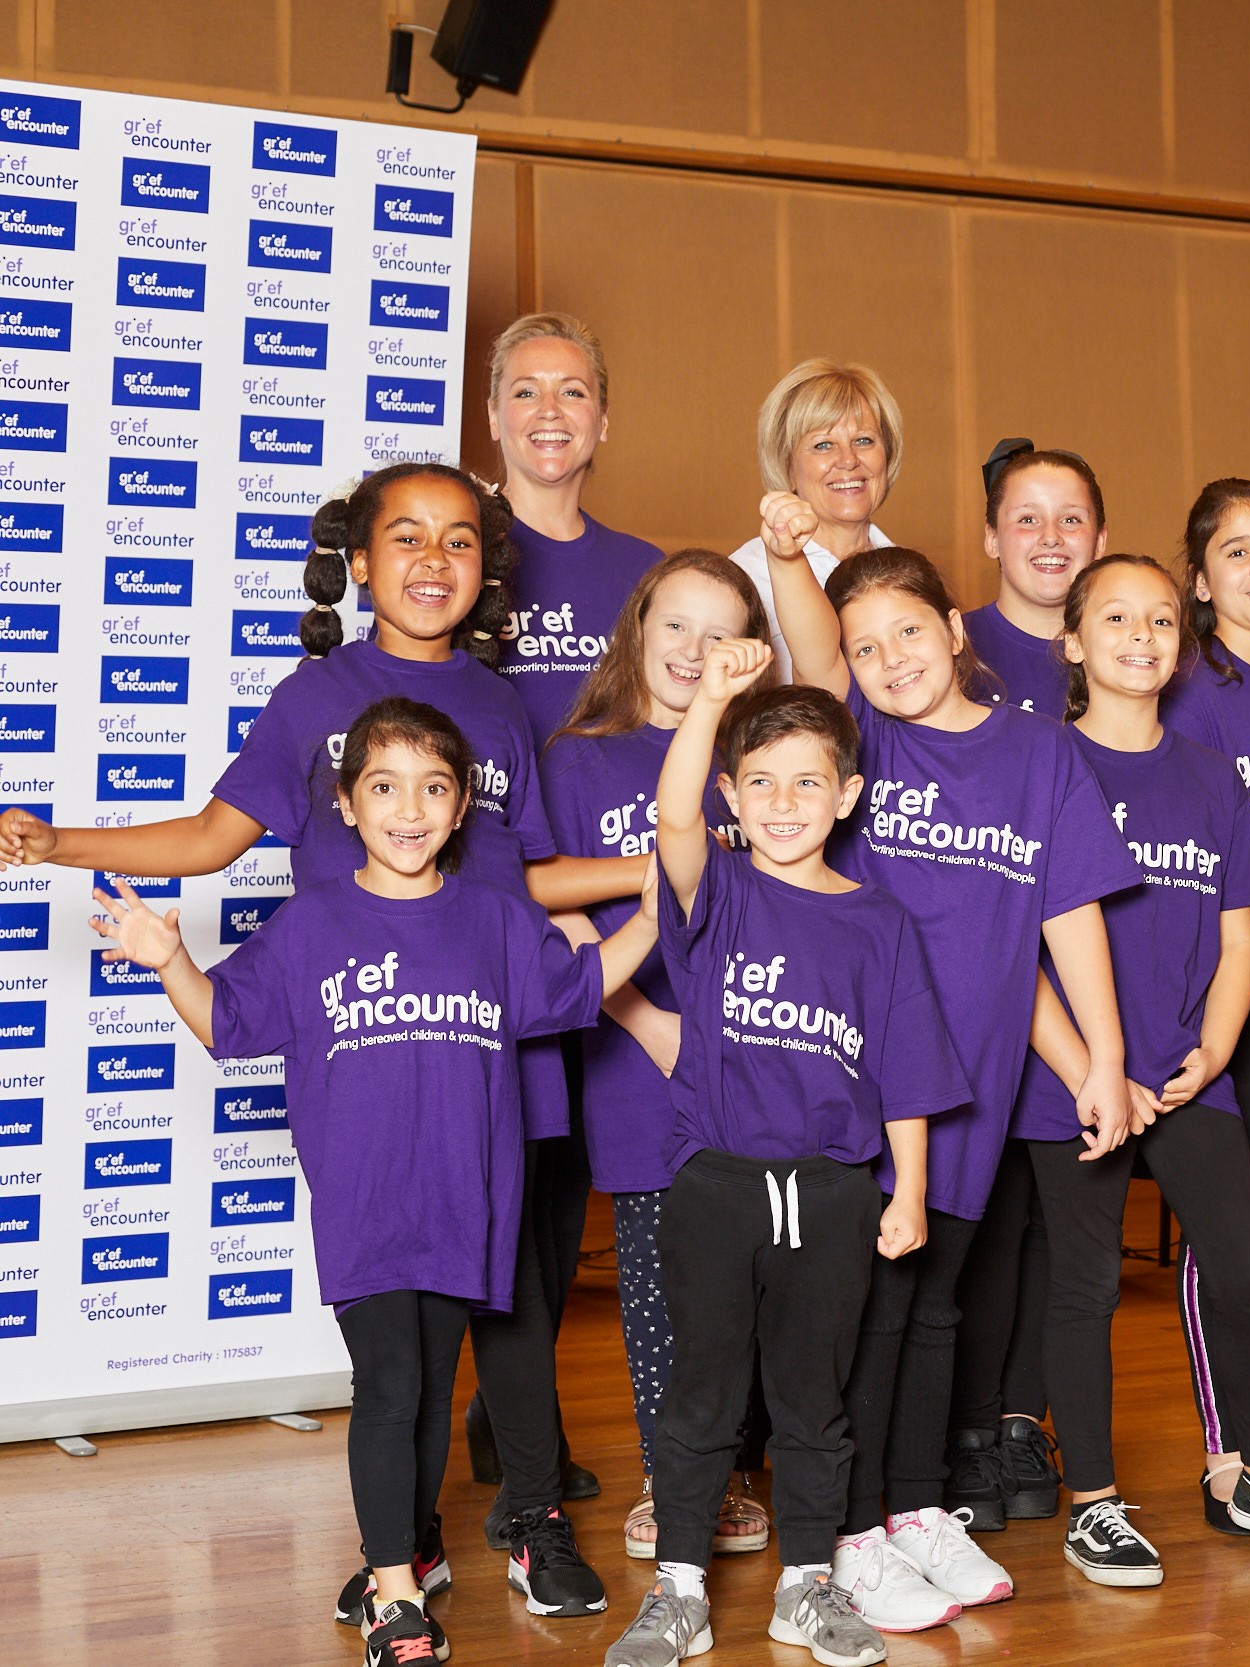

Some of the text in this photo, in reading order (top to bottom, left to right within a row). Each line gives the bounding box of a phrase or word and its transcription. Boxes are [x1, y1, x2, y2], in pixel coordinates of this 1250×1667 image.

[1, 107, 32, 122] gref
[7, 120, 69, 135] encounter
[124, 118, 163, 136] gref
[131, 134, 211, 153] encounter
[263, 137, 292, 151] gref
[268, 148, 326, 163] encounter
[377, 147, 412, 164] gref
[384, 162, 455, 180] encounter
[133, 173, 163, 187] gref
[139, 185, 199, 200] encounter
[252, 182, 289, 199] gref
[259, 197, 334, 215] encounter
[384, 199, 411, 213] gref
[389, 211, 444, 225] encounter
[373, 242, 409, 259] gref
[380, 258, 451, 274] encounter
[128, 272, 159, 286] gref
[133, 284, 194, 298] encounter
[247, 280, 284, 297] gref
[254, 296, 330, 312] encounter
[380, 294, 407, 308] gref
[385, 305, 440, 319] encounter
[115, 318, 154, 336] gref
[122, 334, 202, 350] encounter
[254, 332, 283, 346] gref
[259, 344, 317, 357] encounter
[376, 389, 404, 402] gref
[381, 401, 436, 413] encounter
[111, 418, 151, 436] gref
[119, 433, 198, 449] encounter
[250, 429, 279, 443] gref
[256, 441, 313, 453] encounter
[115, 570, 146, 585] gref
[121, 582, 182, 594] encounter
[498, 661, 549, 674] supporting
[551, 661, 590, 671] bereaved
[99, 715, 138, 733] gref
[106, 729, 186, 742] encounter
[870, 779, 940, 817] gref
[873, 810, 1042, 866] encounter
[937, 854, 976, 866] children
[978, 857, 986, 868] &
[1008, 870, 1036, 885] people
[1164, 875, 1171, 886] &
[1173, 877, 1200, 890] young
[320, 951, 399, 1018] gref
[89, 1006, 128, 1025] gref
[334, 989, 502, 1033] encounter
[97, 1019, 176, 1034] encounter
[723, 990, 864, 1061] encounter
[361, 1030, 408, 1047] bereaved
[410, 1029, 446, 1041] children
[449, 1031, 456, 1041] &
[742, 1036, 832, 1056] ereaved children &
[98, 1057, 128, 1073] gref
[103, 1066, 164, 1080] encounter
[214, 1141, 251, 1162] gref
[221, 1153, 297, 1171] encounter
[221, 1192, 250, 1207] gref
[226, 1200, 285, 1214] encounter
[83, 1198, 121, 1218] gref
[90, 1208, 170, 1226] encounter
[211, 1235, 248, 1255] gref
[92, 1248, 122, 1265] gref
[218, 1246, 294, 1263] encounter
[98, 1256, 158, 1271] encounter
[218, 1284, 247, 1300] gref
[223, 1291, 282, 1307] encounter
[107, 1355, 168, 1371] Registered
[172, 1351, 213, 1364] Charity
[223, 1346, 263, 1359] 1175837
[383, 1605, 398, 1622] NIKE
